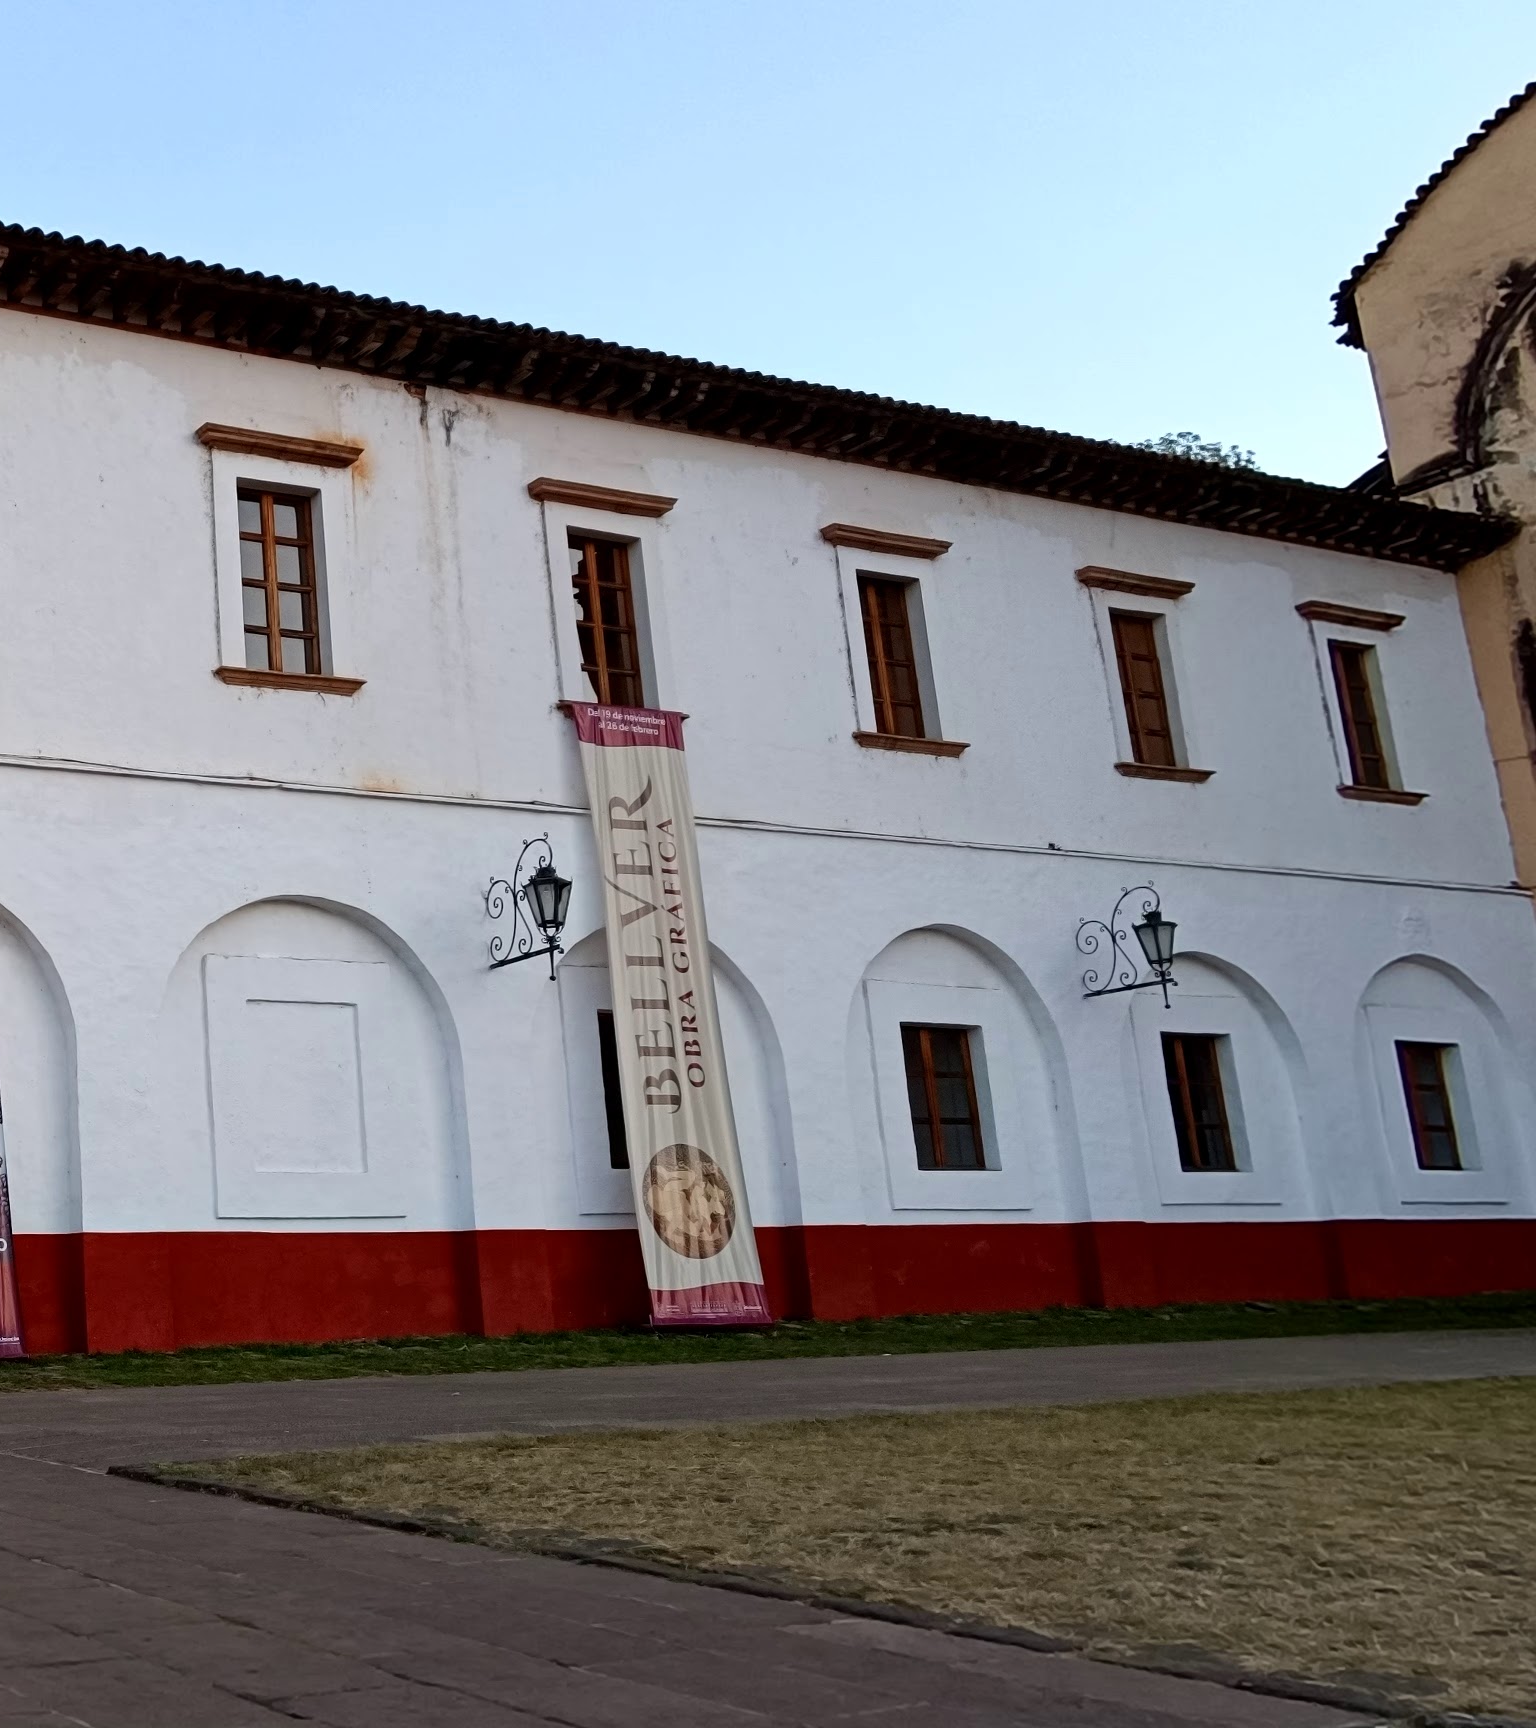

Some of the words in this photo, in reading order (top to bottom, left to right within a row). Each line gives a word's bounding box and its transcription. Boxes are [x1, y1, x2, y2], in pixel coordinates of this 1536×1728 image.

[587, 707, 600, 717] Del
[612, 710, 624, 720] de
[624, 713, 666, 726] noviembre
[619, 723, 630, 732] de
[631, 724, 659, 736] febrero
[604, 774, 682, 1114] BELLVER
[655, 817, 690, 974] GRÁFICA
[677, 990, 706, 1087] OBRA
